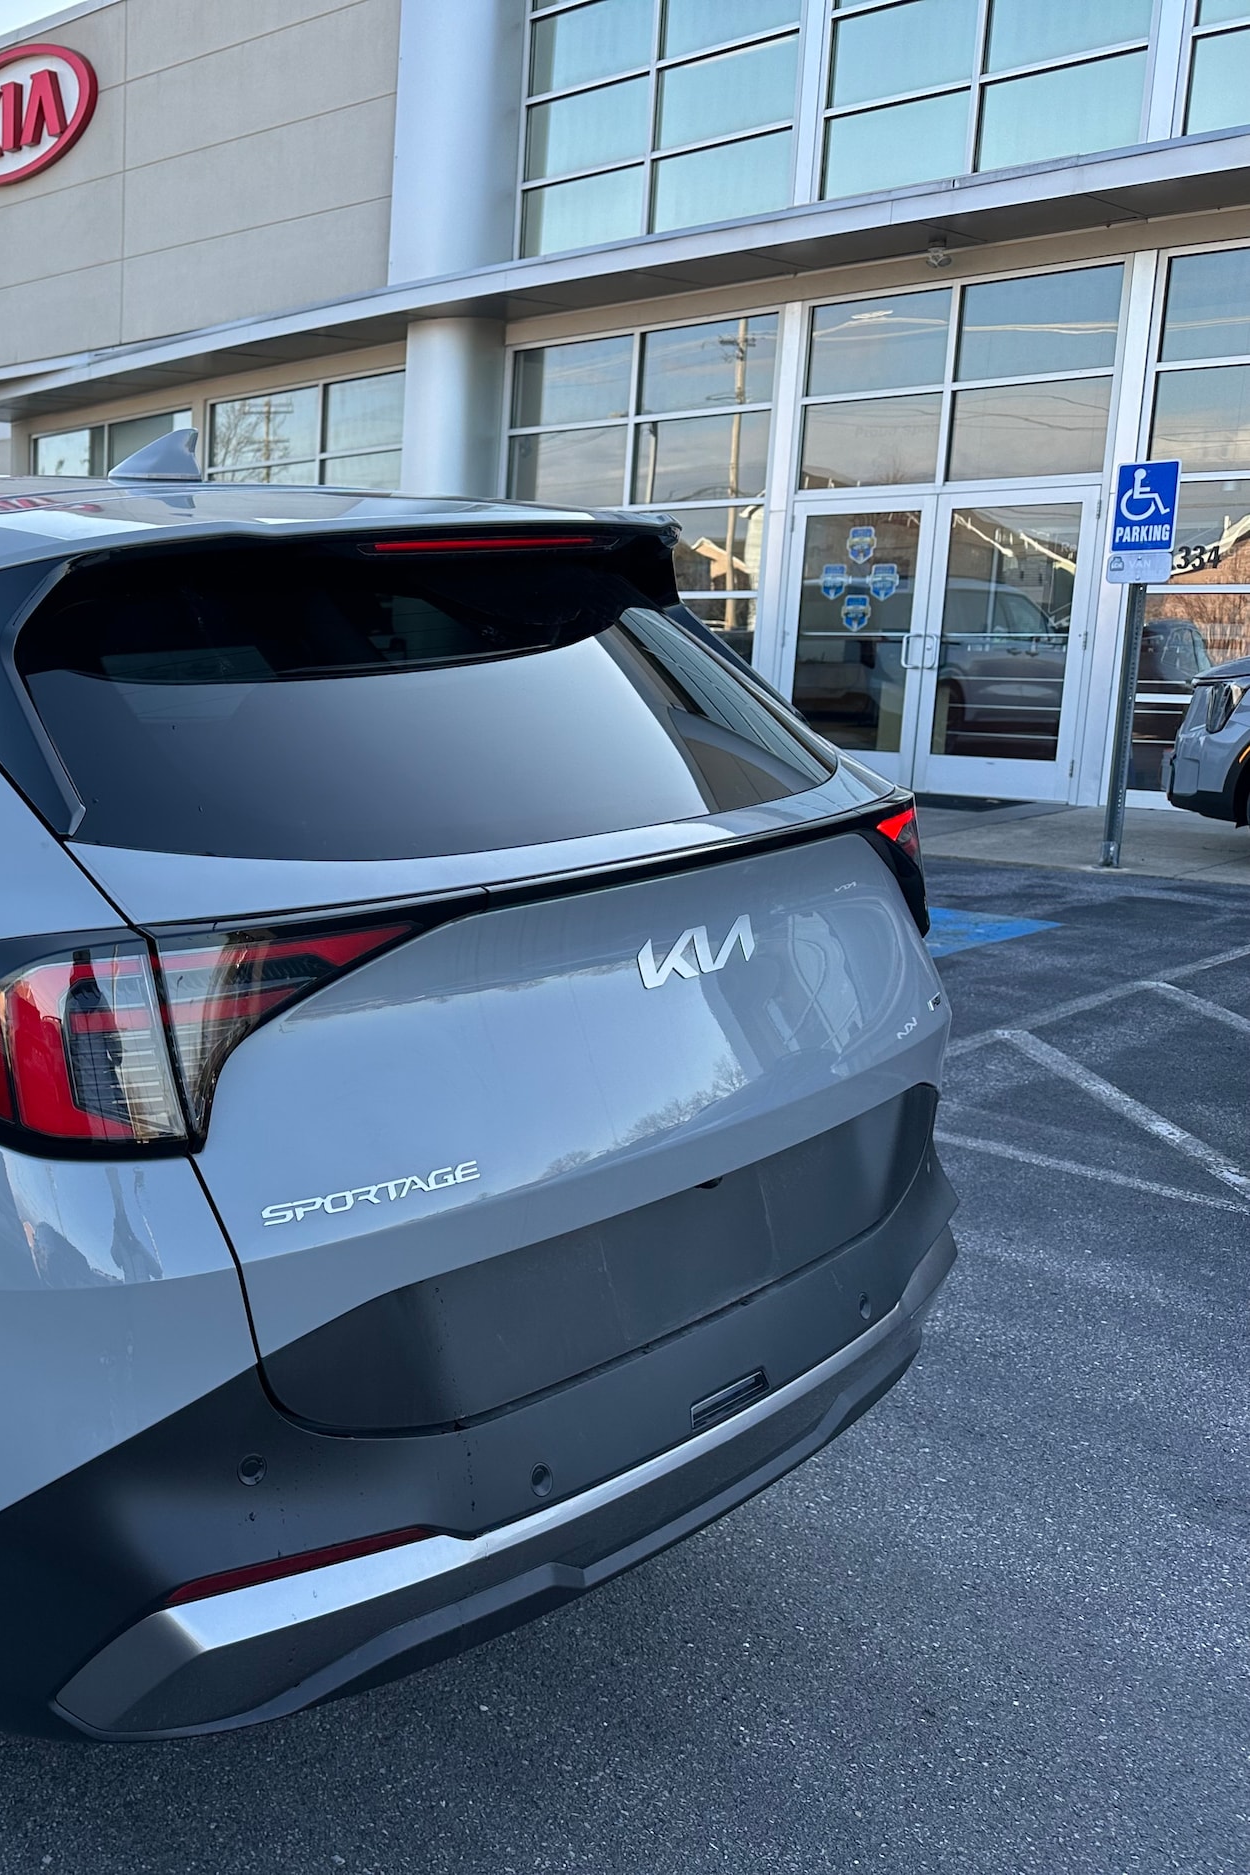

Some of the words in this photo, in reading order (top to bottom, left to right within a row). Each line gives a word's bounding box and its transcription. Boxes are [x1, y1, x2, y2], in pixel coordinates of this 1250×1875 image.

[1114, 523, 1170, 543] PARKING
[1129, 559, 1152, 568] VAN
[1172, 544, 1221, 570] 334
[637, 913, 756, 990] KIA
[261, 1160, 481, 1226] SPORTAGE
